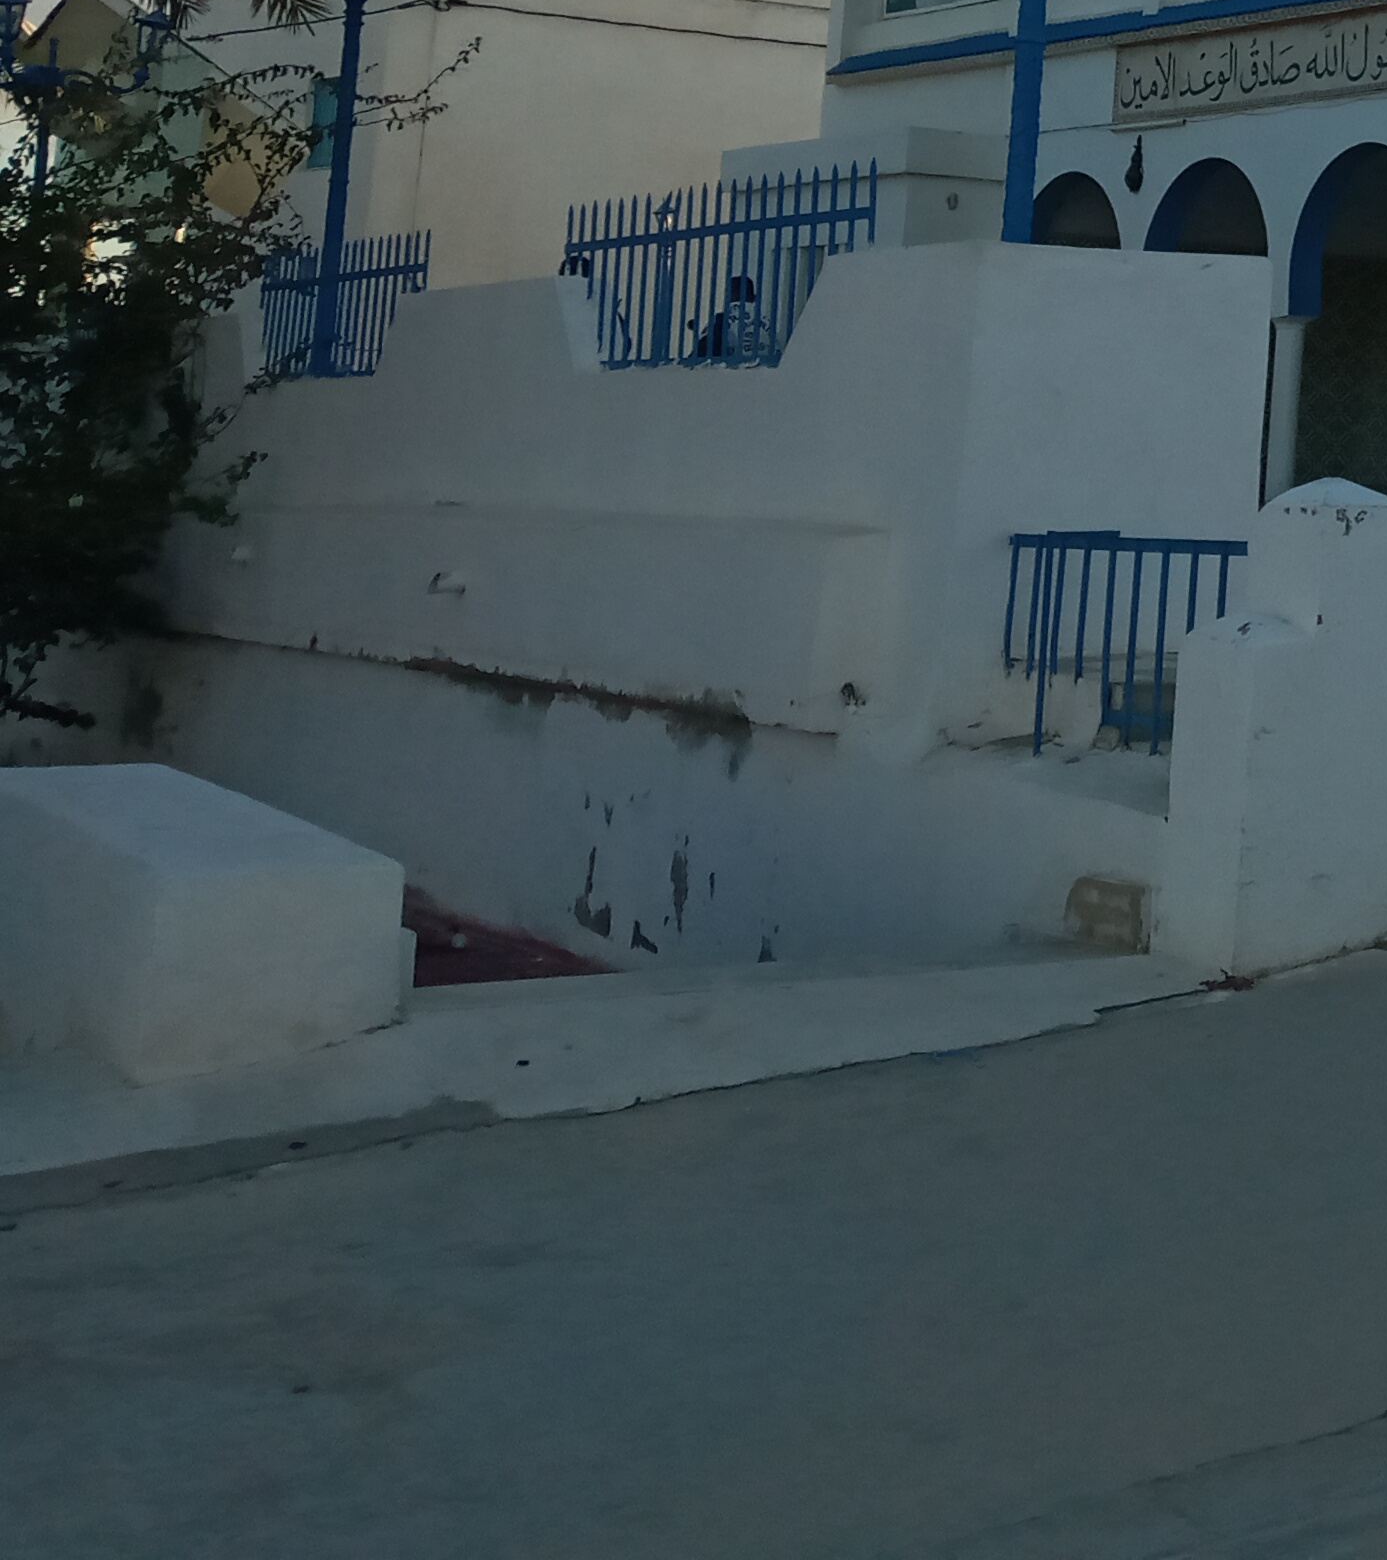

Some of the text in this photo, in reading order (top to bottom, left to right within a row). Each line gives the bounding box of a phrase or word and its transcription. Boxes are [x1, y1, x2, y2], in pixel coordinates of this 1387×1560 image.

[1179, 41, 1238, 102] الوعد
[1239, 36, 1302, 94] صادق
[1306, 25, 1345, 81] الله
